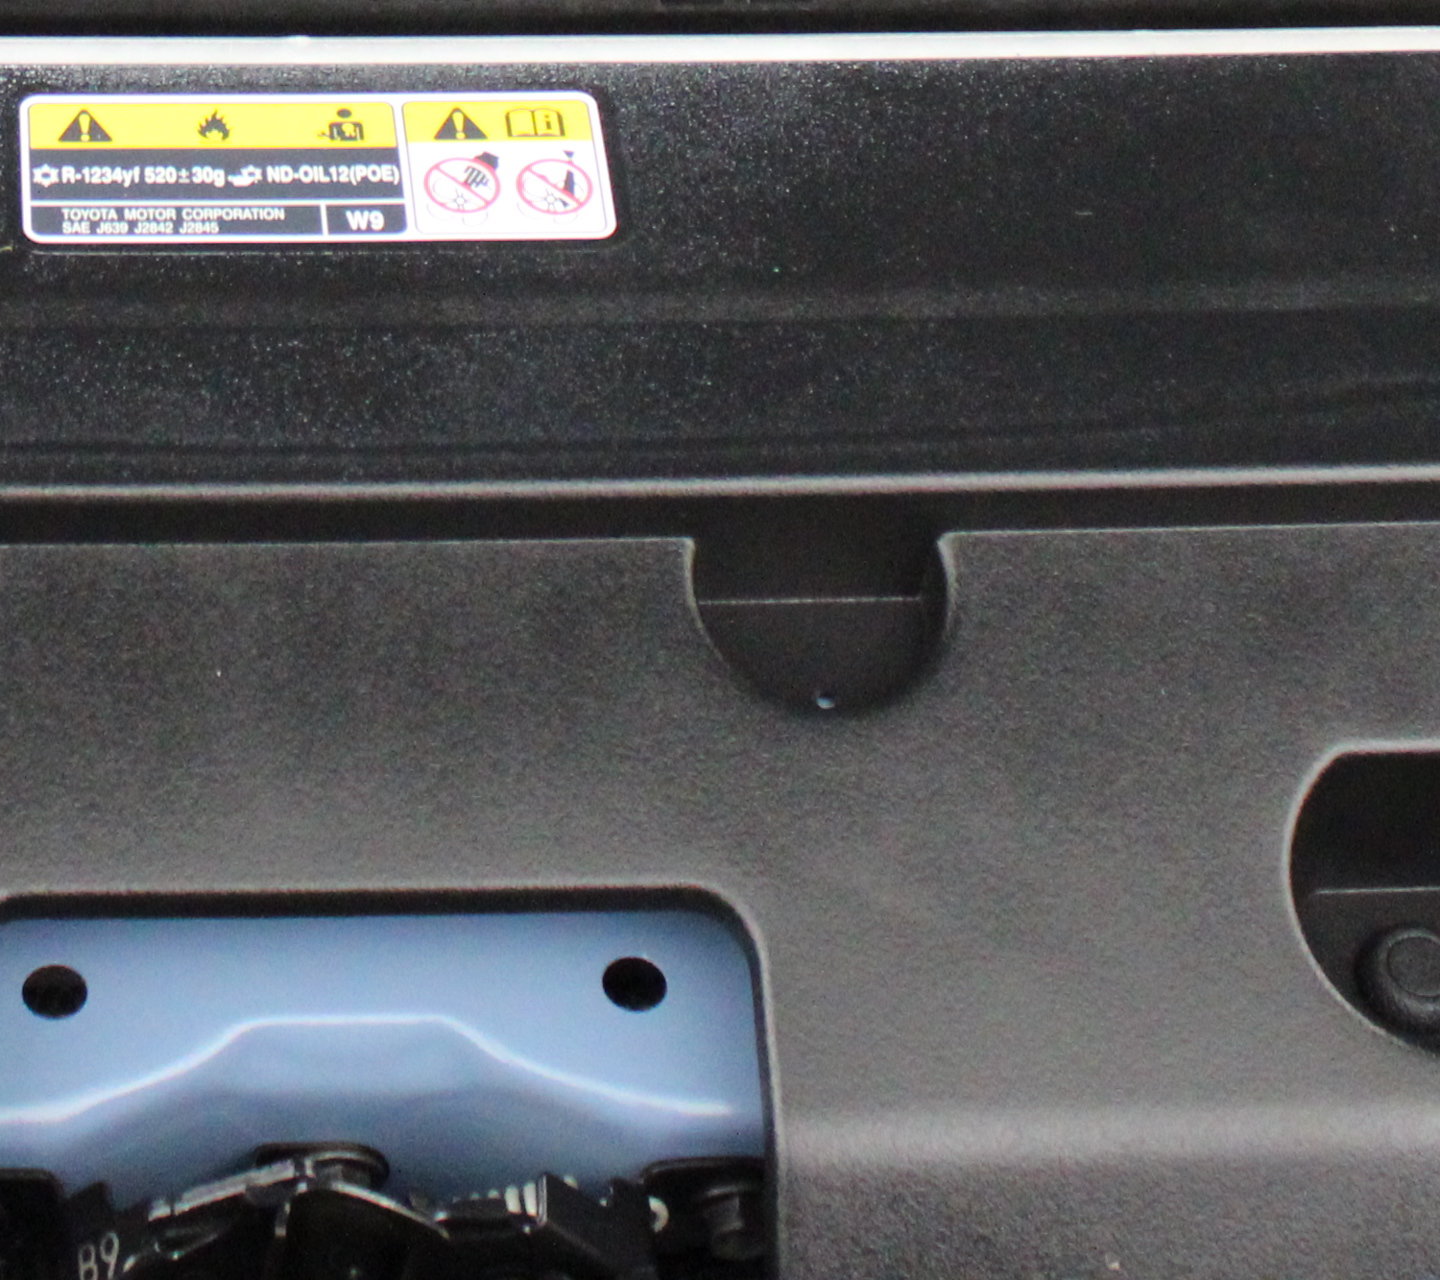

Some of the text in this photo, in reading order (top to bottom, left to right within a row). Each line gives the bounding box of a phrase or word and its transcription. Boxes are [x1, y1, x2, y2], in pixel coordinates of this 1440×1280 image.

[60, 164, 400, 188] R-1234yf 520±30g ND-OIL12(POE)
[61, 207, 286, 221] TOYOTA MOTOR CORPORATION
[345, 210, 385, 231] W9
[61, 221, 220, 235] SAE J639 J2842 J2845
